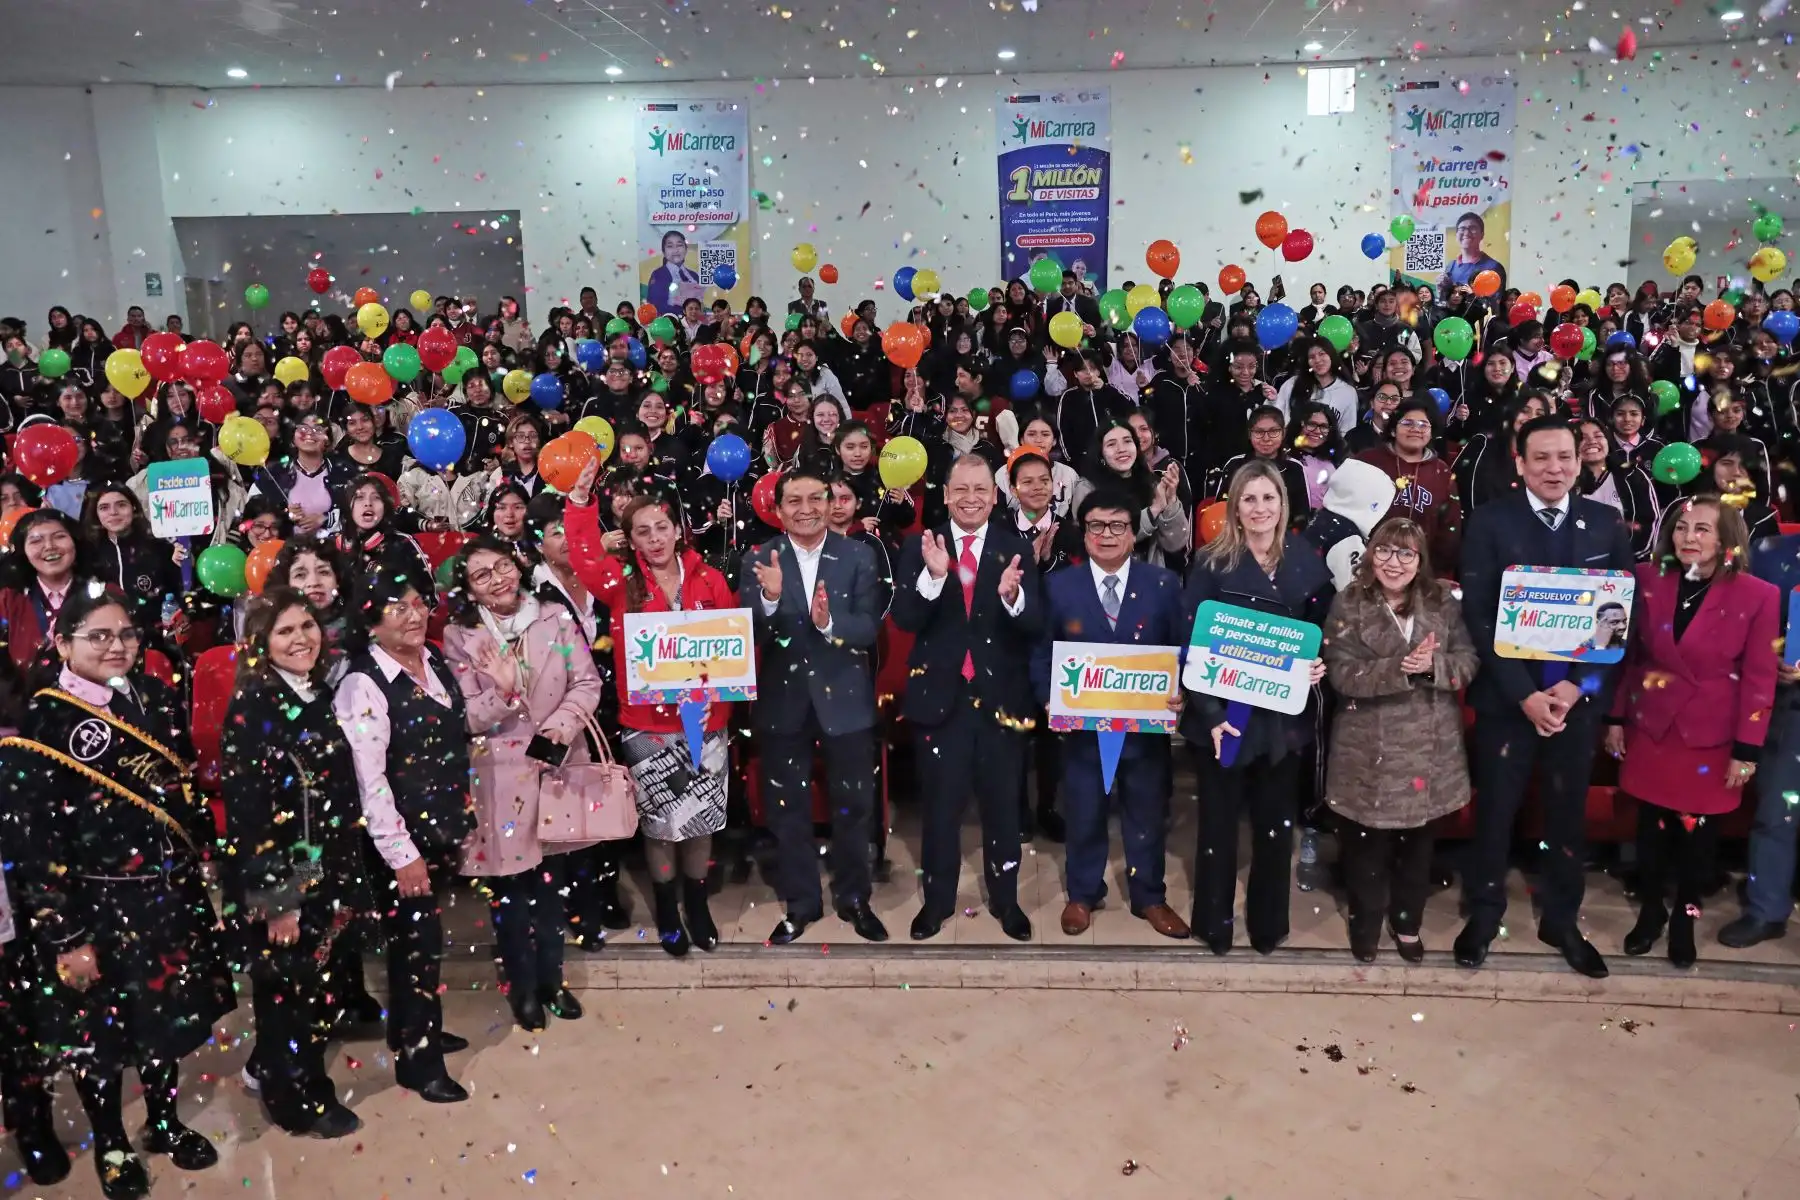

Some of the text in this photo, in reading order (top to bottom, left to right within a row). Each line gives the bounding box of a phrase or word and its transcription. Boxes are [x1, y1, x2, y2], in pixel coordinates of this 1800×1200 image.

[1426, 110, 1500, 130] MiCarrera
[1030, 120, 1095, 138] MiCarrera
[668, 133, 735, 150] MiCarrera
[1419, 160, 1488, 172] Mi carrera
[688, 176, 711, 185] Da el
[1008, 164, 1102, 200] 1 MILLÓN
[1418, 177, 1480, 189] Mi futuro
[660, 187, 724, 198] primer paso
[1040, 189, 1094, 199] DE VISITAS
[1433, 193, 1478, 208] pasión
[664, 201, 683, 209] para
[652, 212, 734, 222] éxito profesional
[158, 476, 198, 489] Decide con
[165, 500, 209, 519] MiCarrera
[1518, 590, 1528, 598] SÍ
[1528, 591, 1572, 601] RESUELVO
[1214, 612, 1304, 640] Súmate al millón
[1520, 610, 1593, 629] MiCarrera
[658, 636, 742, 659] MiCarrera
[1209, 625, 1301, 654] de personas que
[1219, 643, 1284, 668] utilizaron
[1083, 668, 1168, 692] MiCarrera
[1219, 667, 1291, 699] MiCarrera
